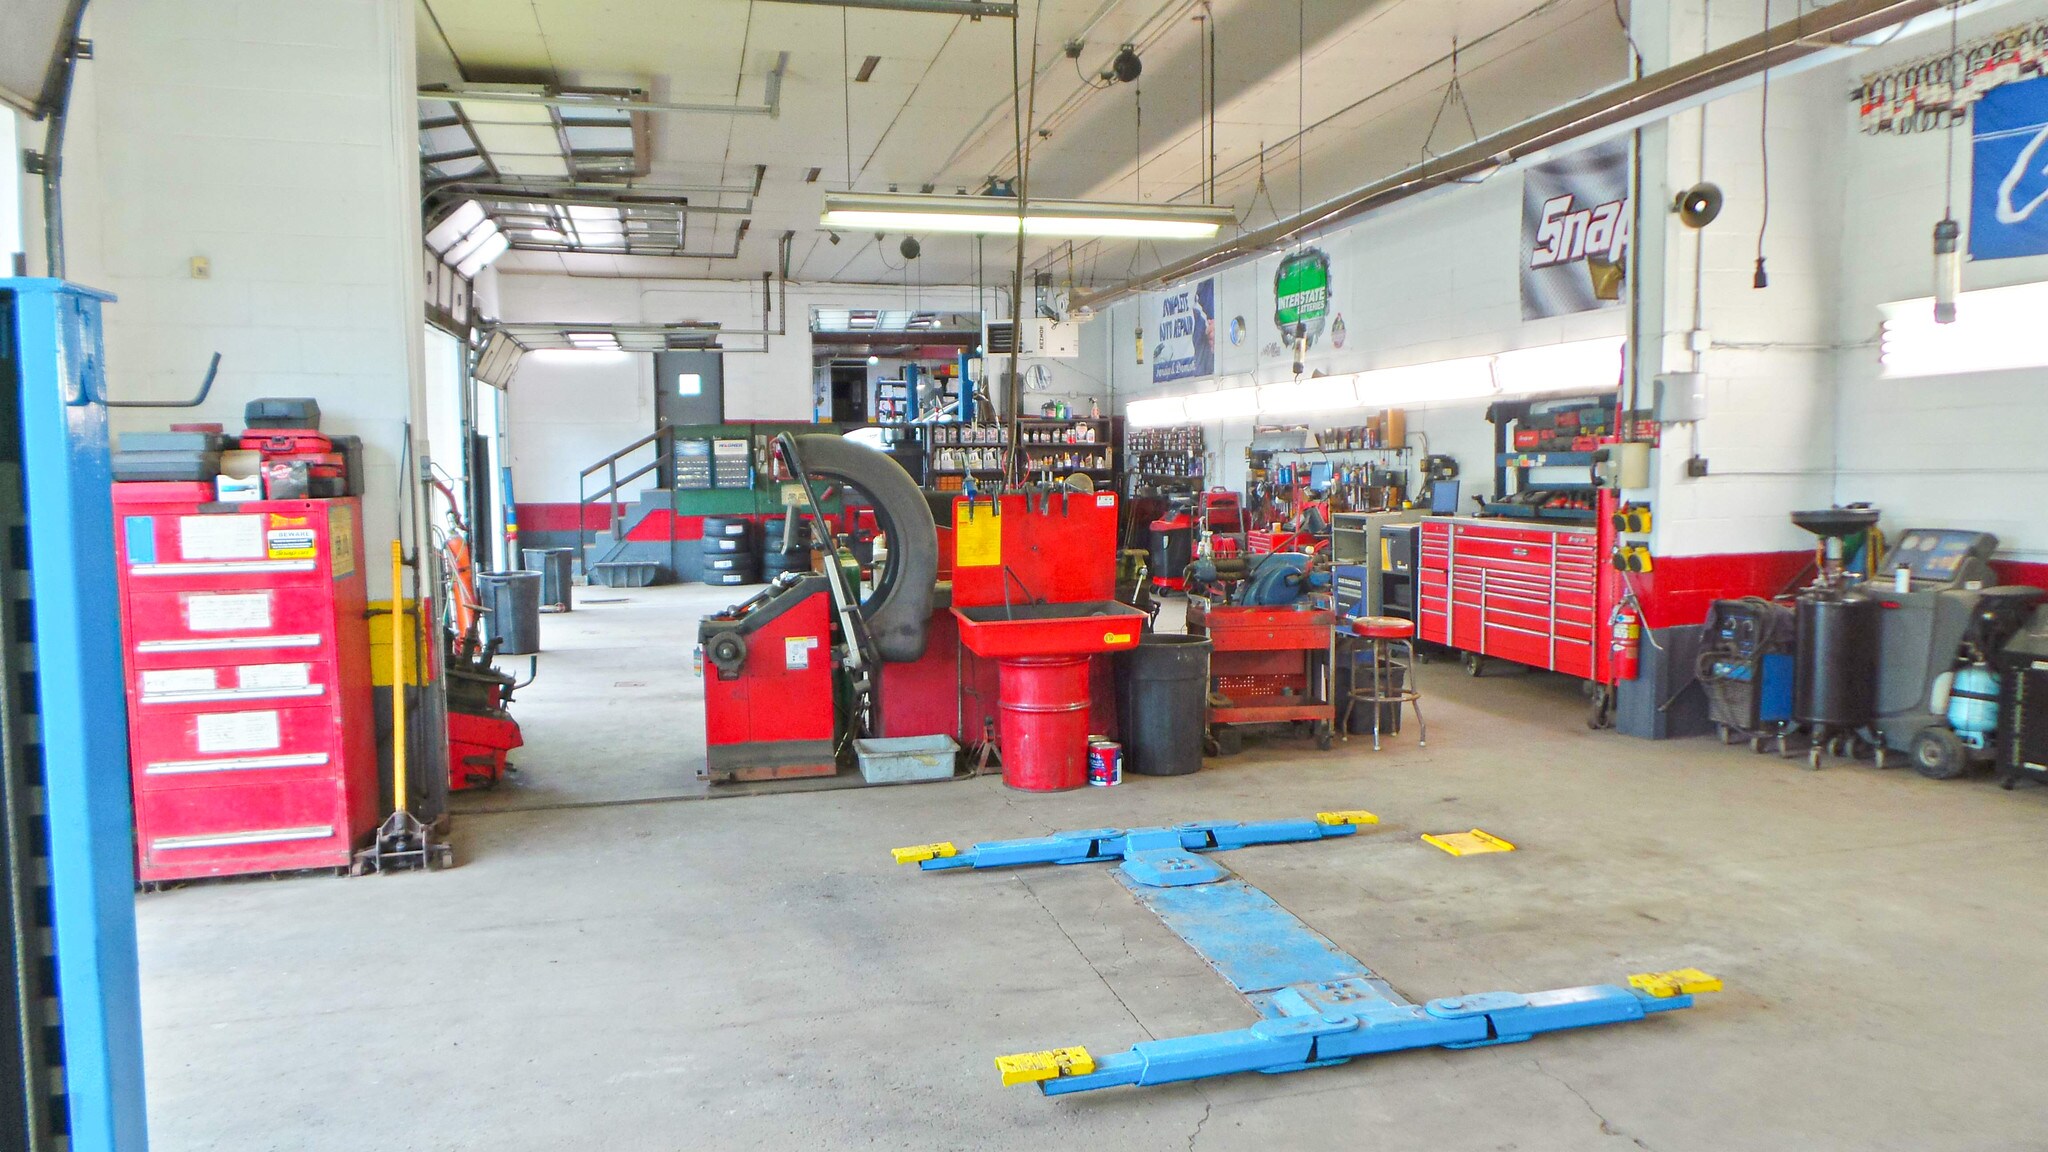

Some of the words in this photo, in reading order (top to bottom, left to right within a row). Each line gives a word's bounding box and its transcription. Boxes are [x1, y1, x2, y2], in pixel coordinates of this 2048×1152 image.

[1278, 287, 1325, 310] INTERSTATE
[1297, 300, 1325, 315] BATTERIES
[1159, 320, 1172, 341] AUTO
[1174, 315, 1193, 338] REPAIR
